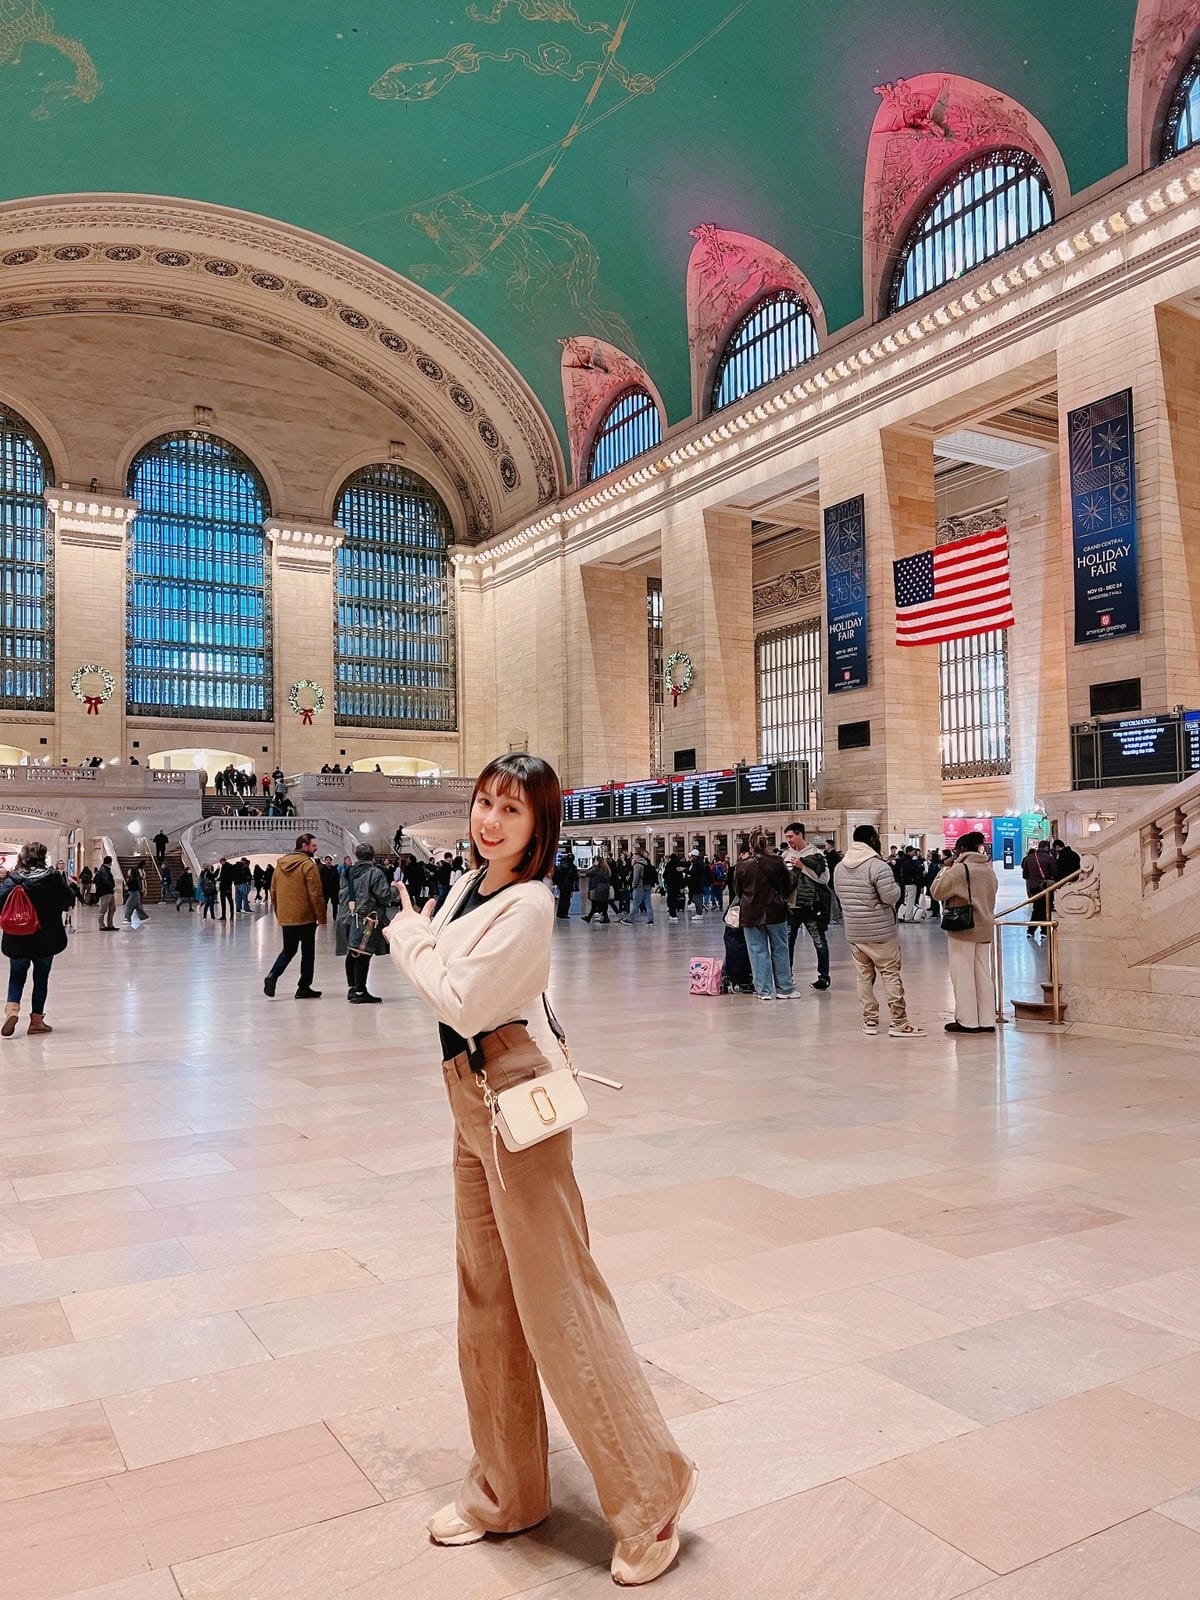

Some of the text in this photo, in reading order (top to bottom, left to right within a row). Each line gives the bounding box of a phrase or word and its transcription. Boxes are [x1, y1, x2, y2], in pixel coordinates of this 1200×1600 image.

[1083, 537, 1123, 552] GRAND CENTRAL
[1077, 543, 1131, 569] HOLIDAY
[1091, 561, 1117, 577] FAIR
[1106, 583, 1116, 591] DEC
[829, 617, 863, 634] HOLIDAY
[838, 629, 854, 641] FAIR
[1120, 718, 1156, 727] INFORMATION
[0, 804, 42, 816] EXINGTON
[419, 810, 451, 820] LEXINGTON
